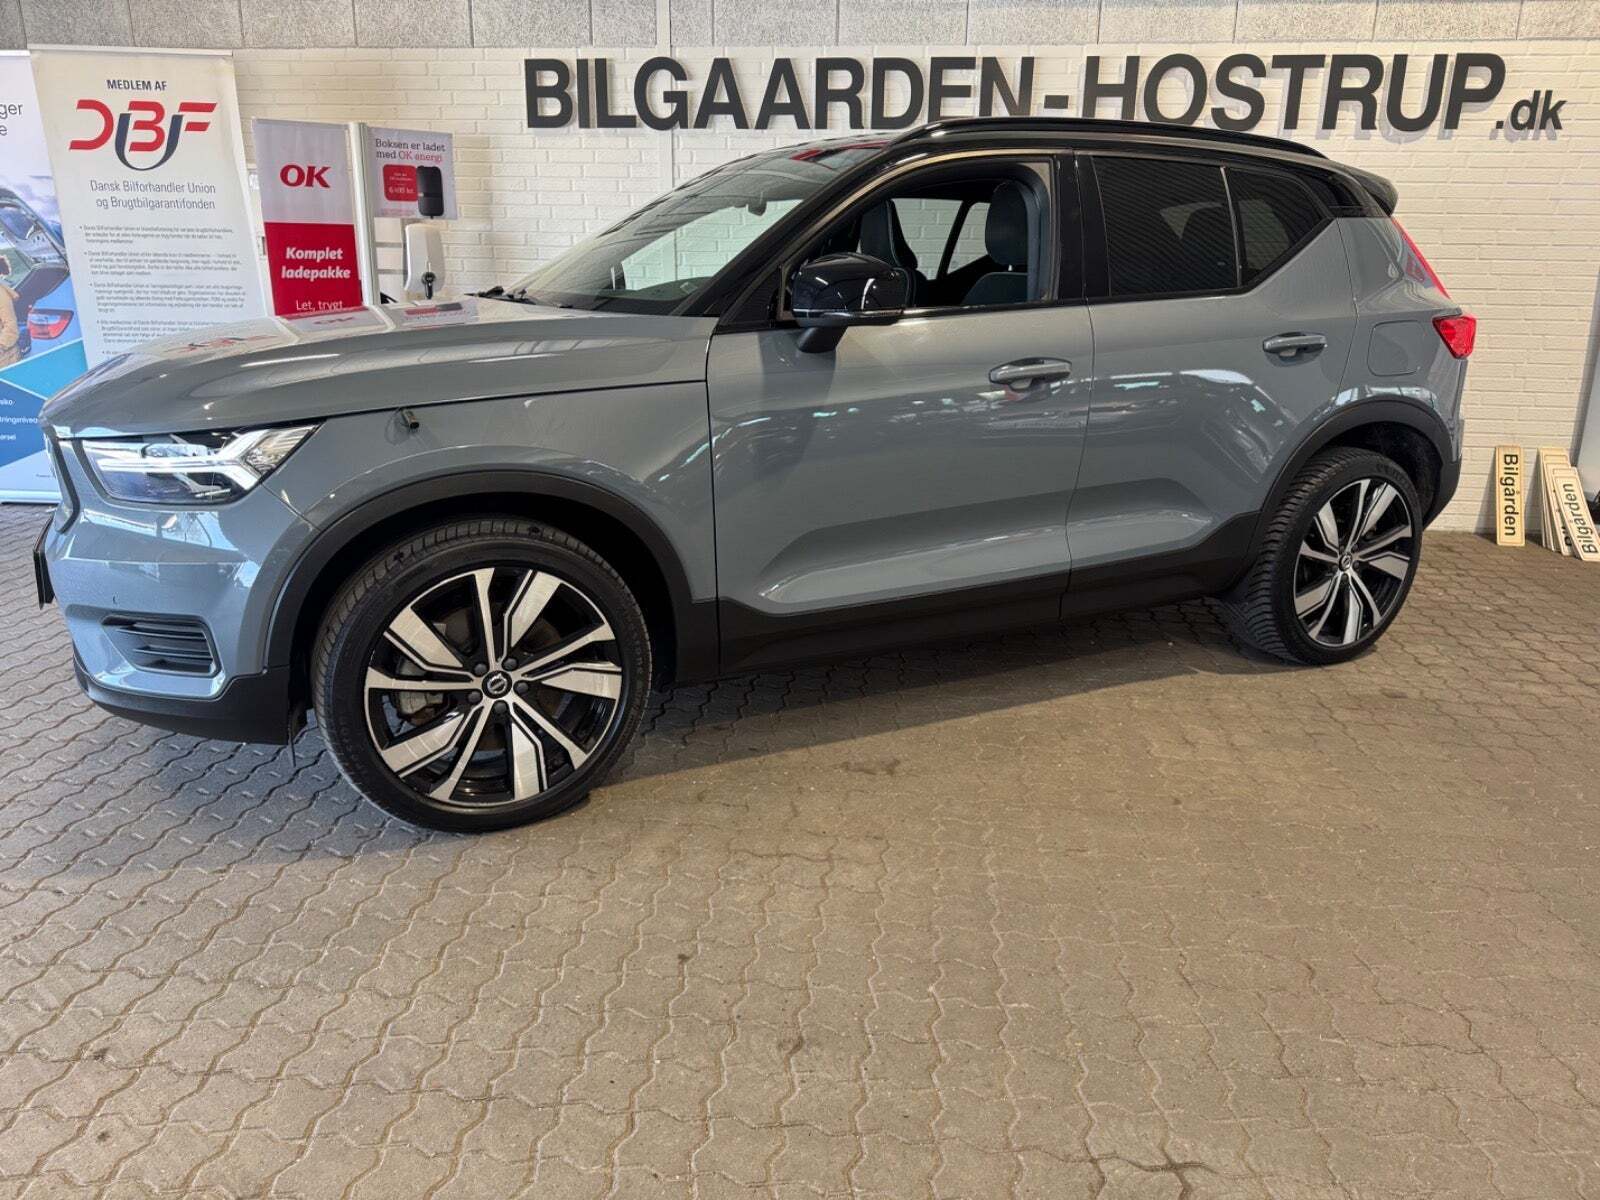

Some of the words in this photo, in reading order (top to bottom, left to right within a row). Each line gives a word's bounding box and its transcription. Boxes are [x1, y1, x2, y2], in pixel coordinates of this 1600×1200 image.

[107, 79, 152, 91] MEDLEM
[155, 80, 168, 92] AF
[375, 138, 409, 148] Boksen
[423, 142, 446, 152] ladet
[376, 150, 396, 160] med
[398, 151, 413, 160] OK
[280, 164, 332, 188] OK
[90, 179, 120, 192] Dansk
[122, 180, 185, 193] Bilforhandler
[187, 182, 216, 194] Union
[96, 198, 109, 210] og
[110, 196, 216, 210] Brugtbilgarantifonden
[286, 246, 343, 263] Komplet
[281, 265, 351, 282] ladepakke
[296, 300, 315, 311] Let,
